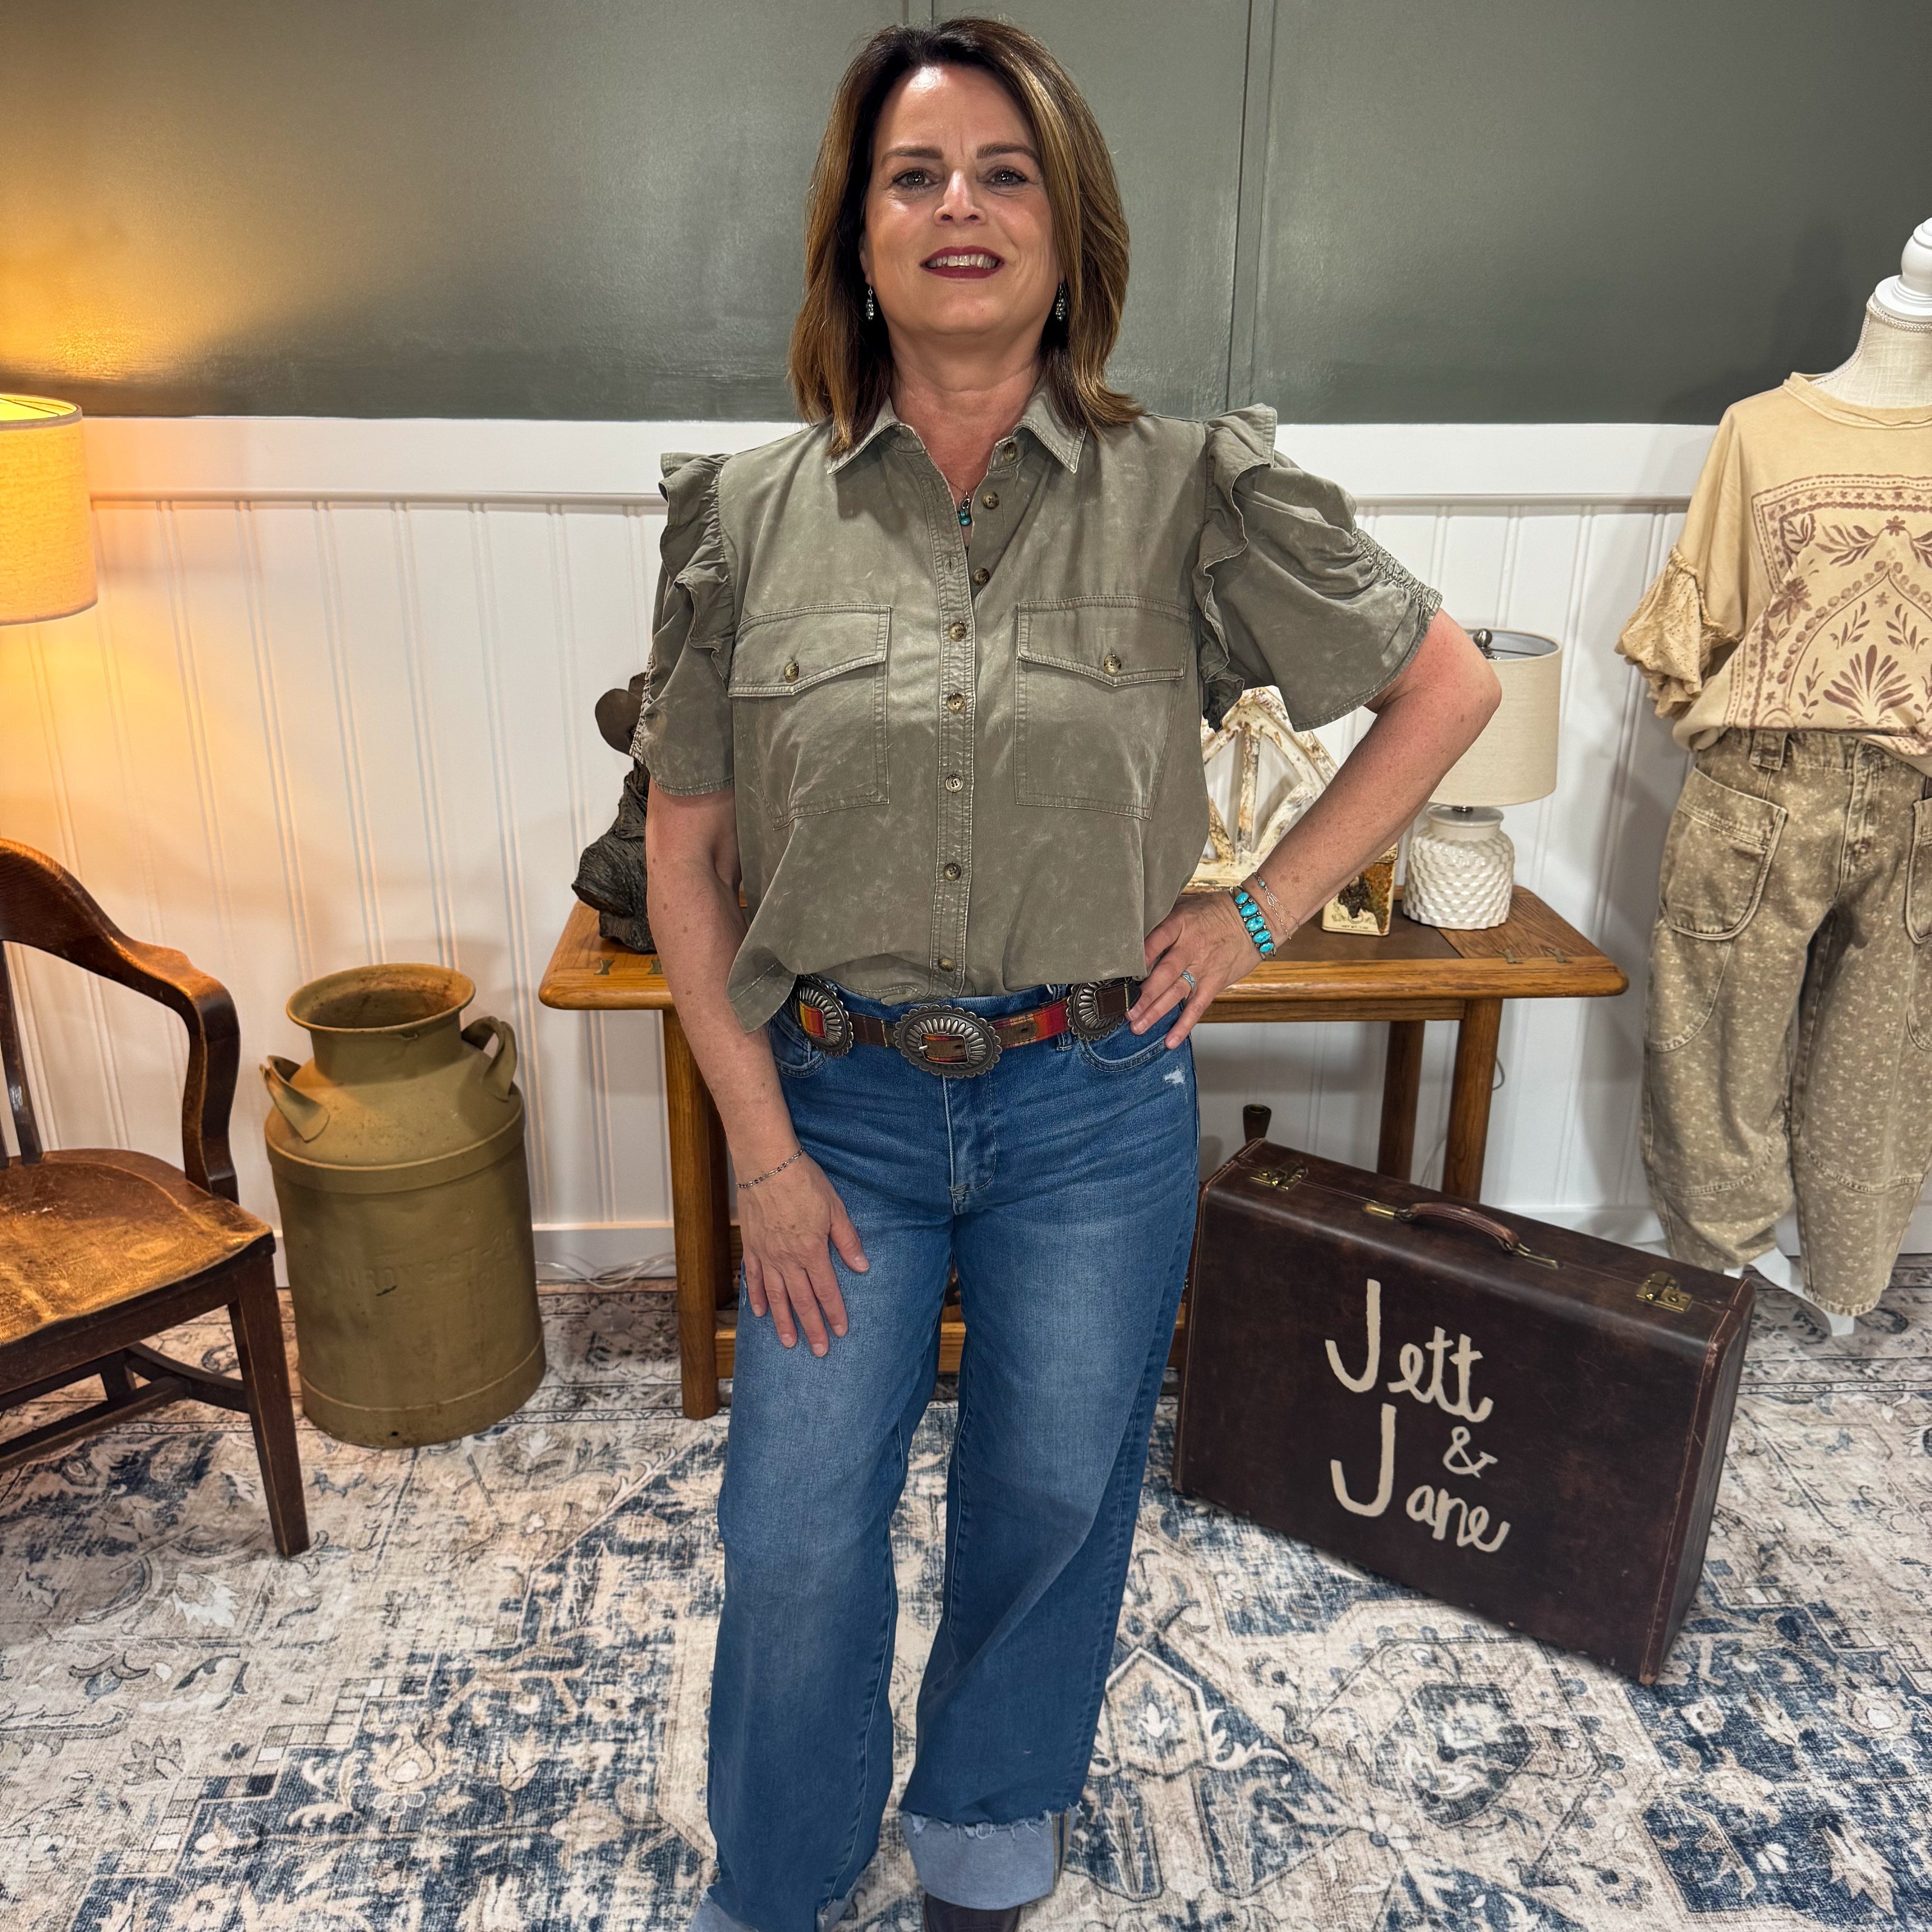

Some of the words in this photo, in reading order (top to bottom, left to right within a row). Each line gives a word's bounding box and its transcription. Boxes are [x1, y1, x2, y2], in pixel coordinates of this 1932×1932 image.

[1325, 1278, 1494, 1423] Jett
[1330, 1403, 1510, 1553] Jane
[1443, 1426, 1498, 1478] &
